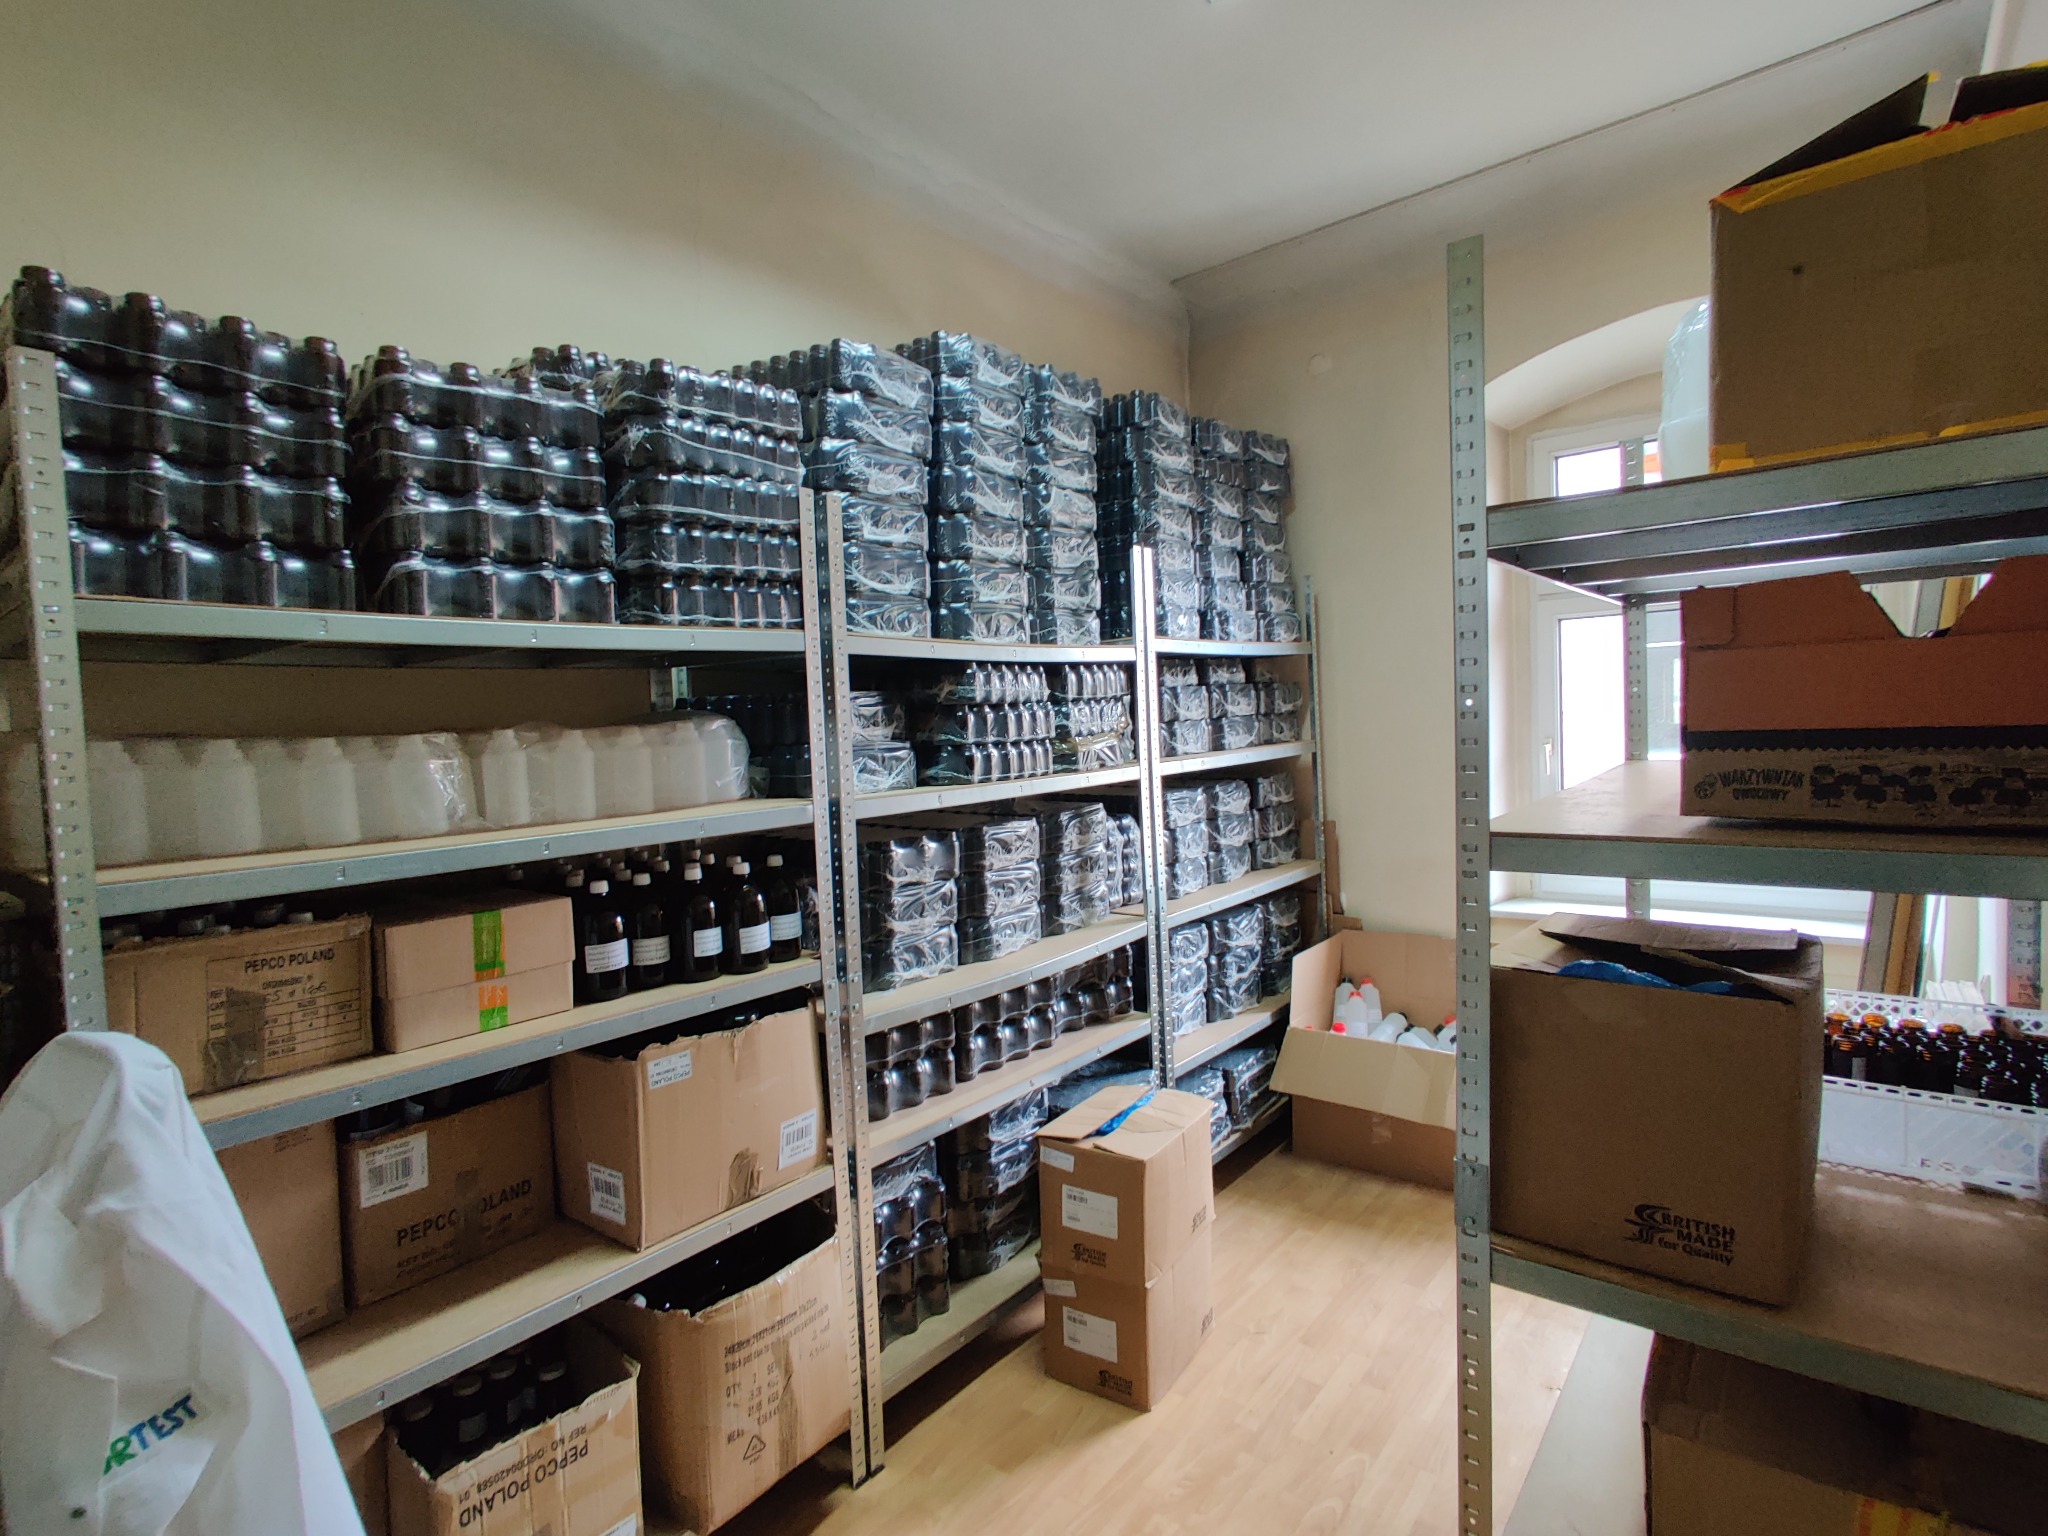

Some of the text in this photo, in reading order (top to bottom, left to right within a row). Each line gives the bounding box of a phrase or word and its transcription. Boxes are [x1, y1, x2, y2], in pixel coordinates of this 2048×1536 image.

[244, 948, 336, 974] PEPCO POLAND
[1661, 1212, 1736, 1240] BRITISH
[1658, 1236, 1735, 1266] for Quality
[1677, 1228, 1734, 1253] MADE
[568, 1423, 587, 1442] REF
[459, 1439, 589, 1528] PEPCO POLAND
